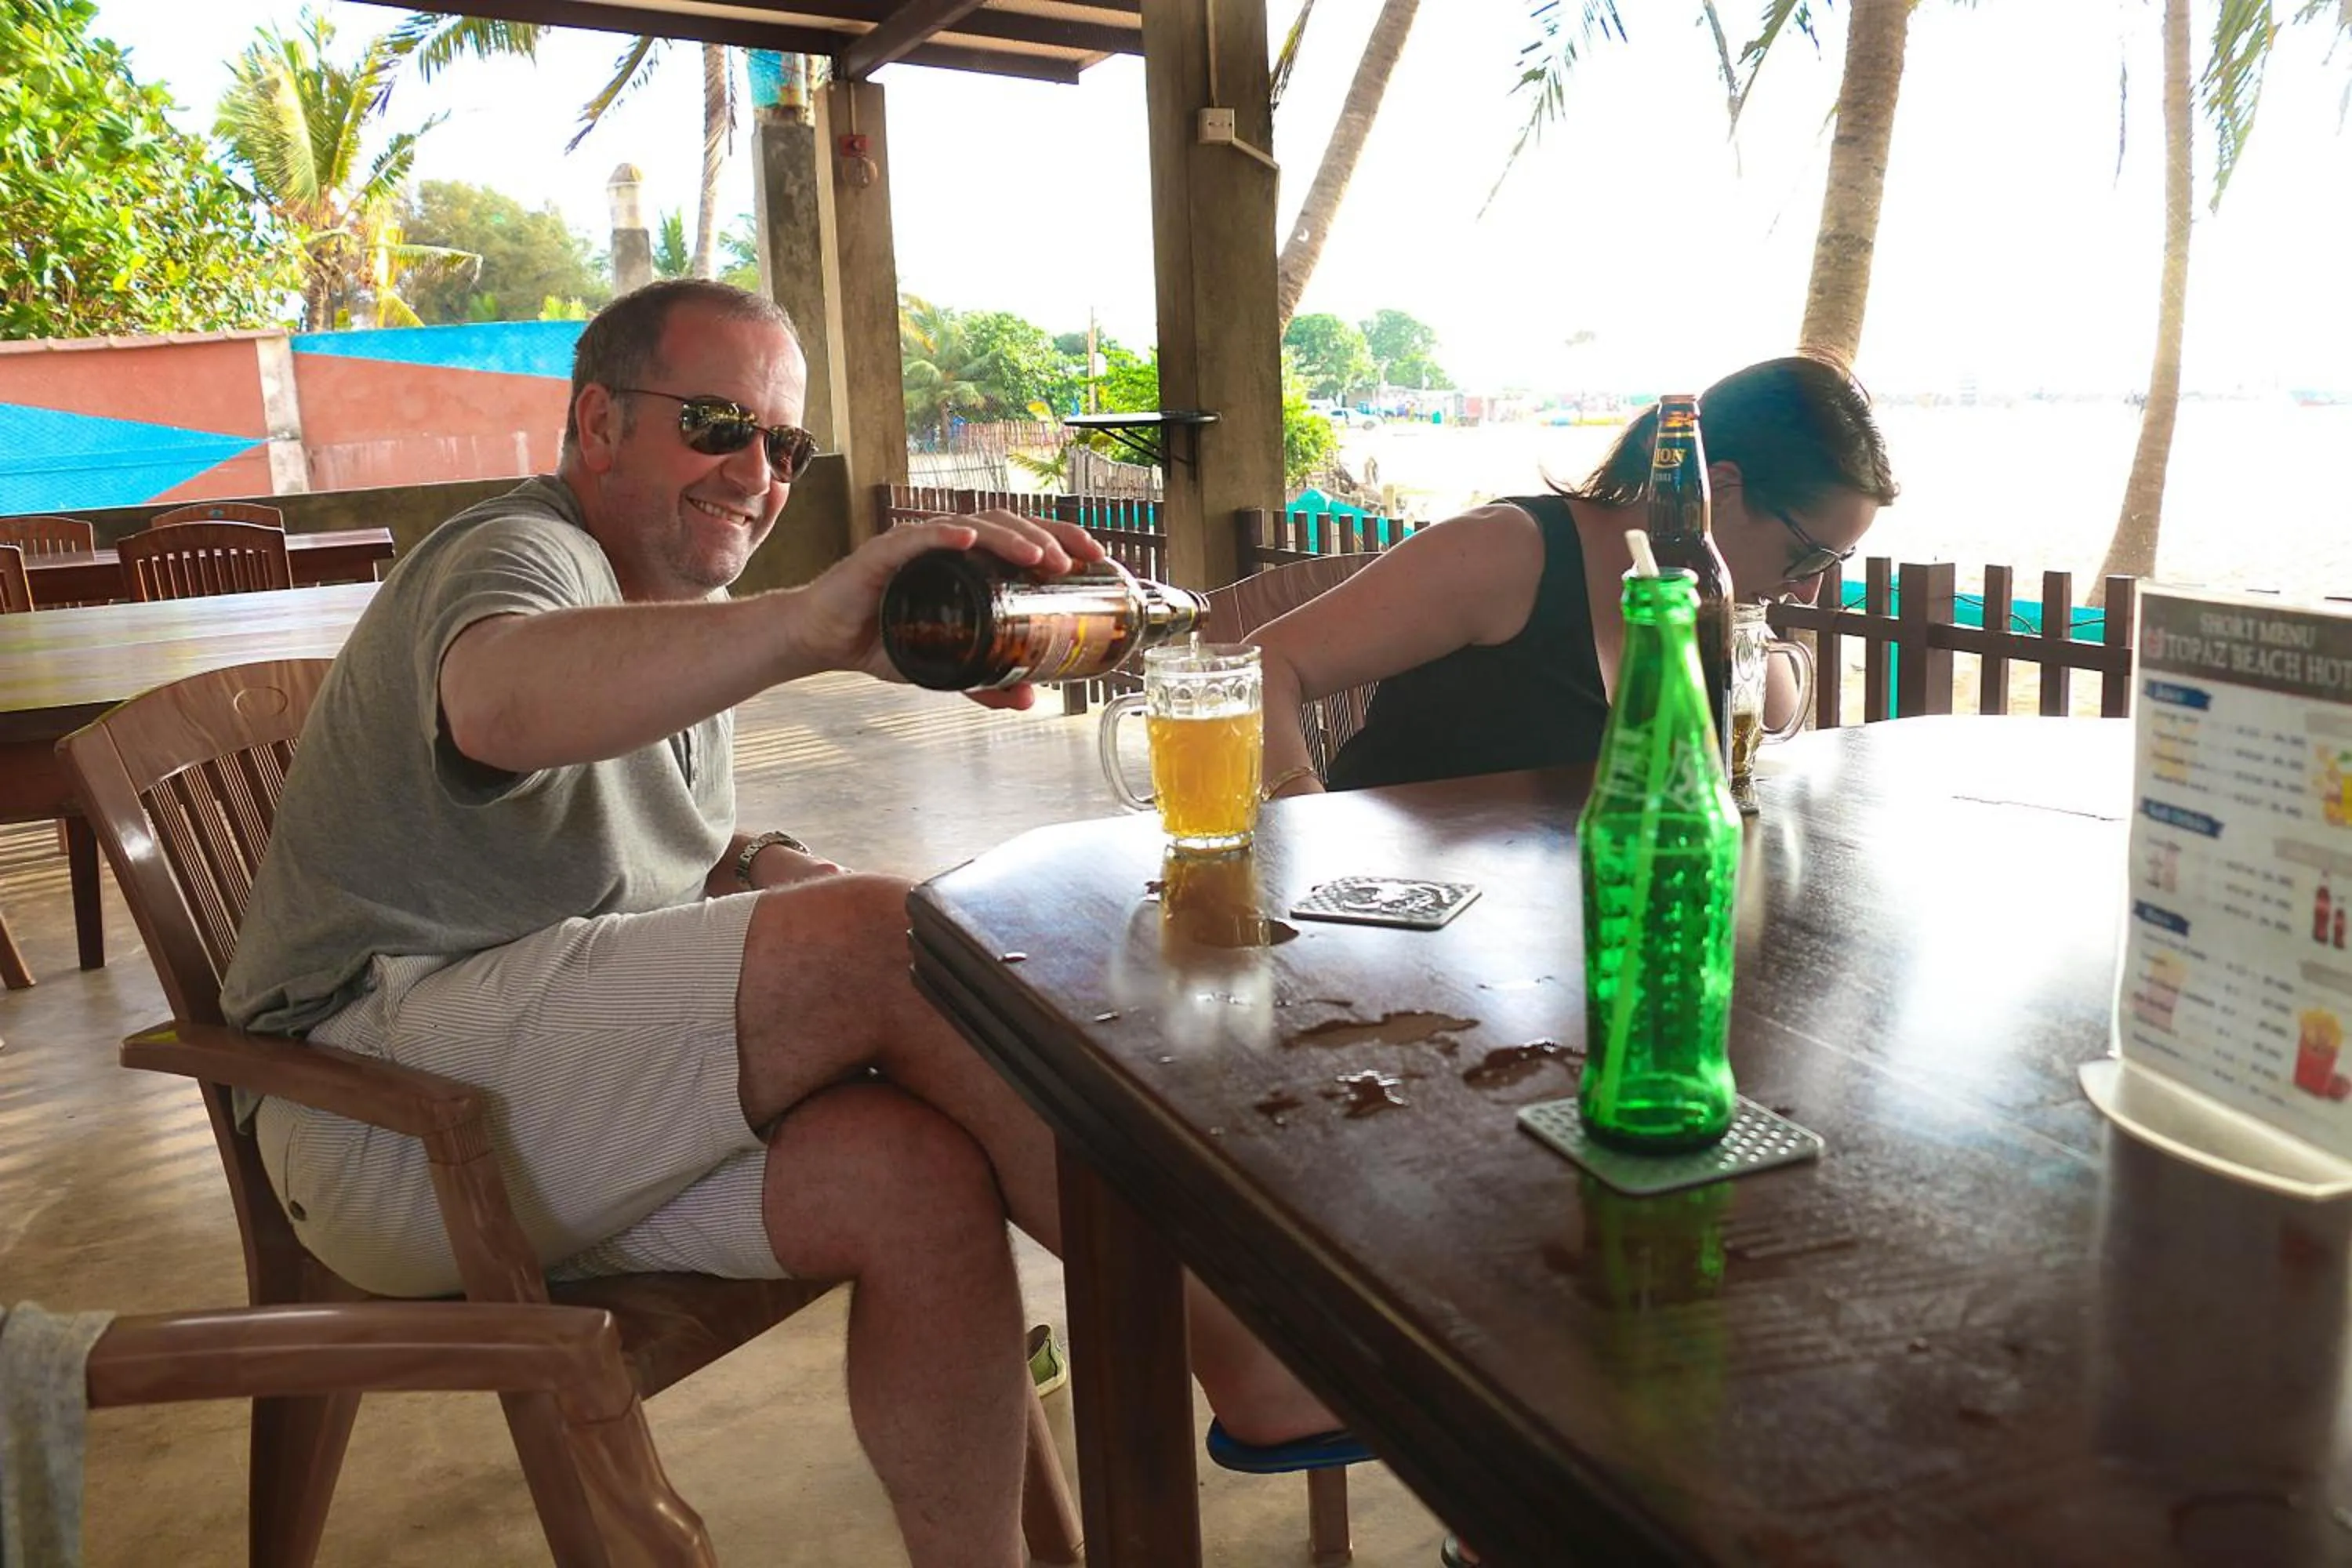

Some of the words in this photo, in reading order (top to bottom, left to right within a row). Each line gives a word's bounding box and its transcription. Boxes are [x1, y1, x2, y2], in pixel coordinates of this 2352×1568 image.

[2199, 612, 2255, 641] SHORT
[2259, 619, 2317, 649] MENU
[2166, 633, 2228, 669] TOPAZ
[2231, 644, 2301, 681] BEACH
